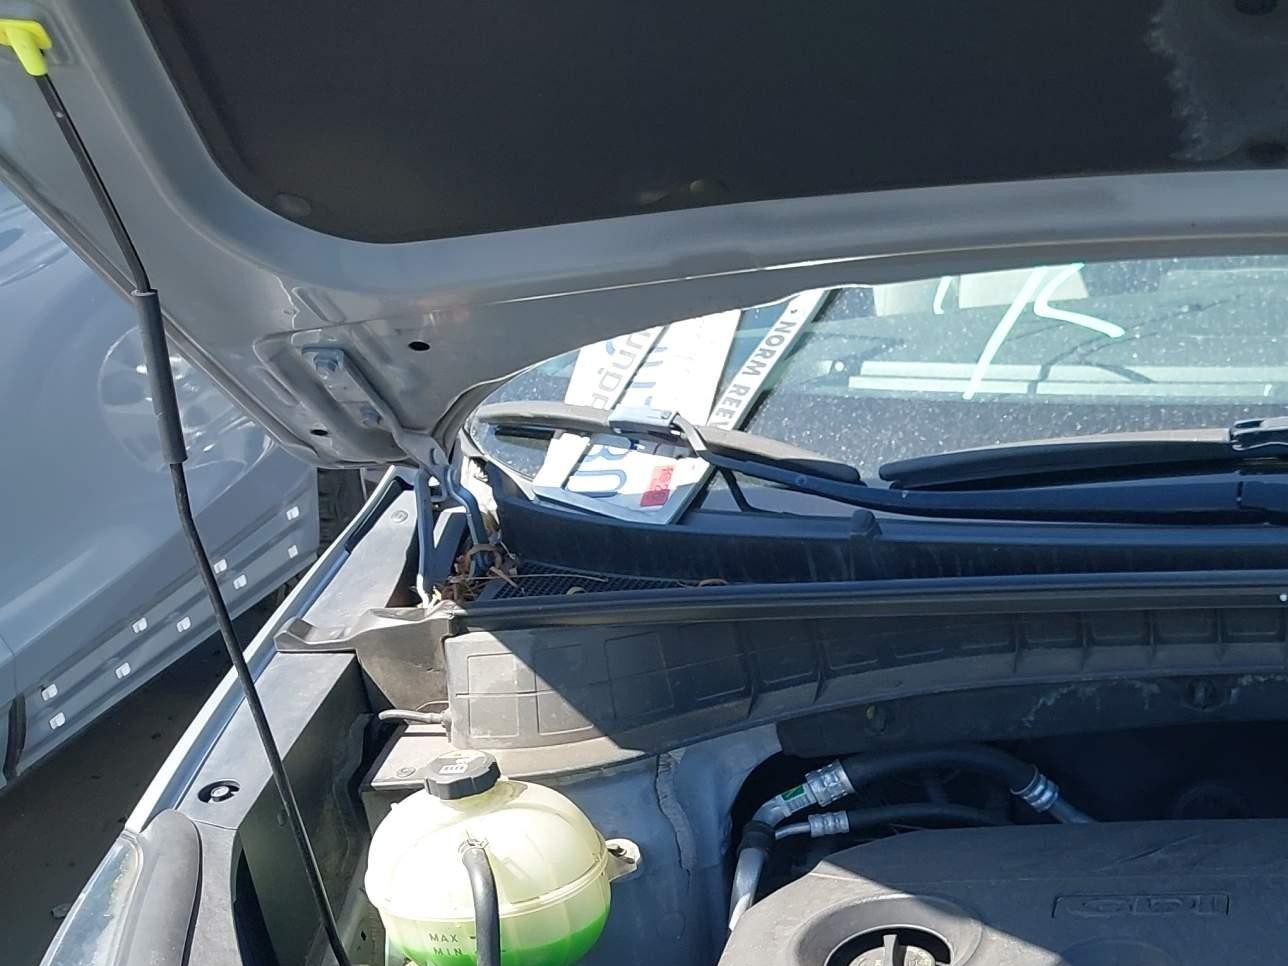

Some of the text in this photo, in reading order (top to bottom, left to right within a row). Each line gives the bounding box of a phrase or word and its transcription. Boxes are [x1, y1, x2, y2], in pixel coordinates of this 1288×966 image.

[741, 320, 796, 377] NORM
[428, 932, 458, 943] MAX
[433, 946, 464, 957] MIN
